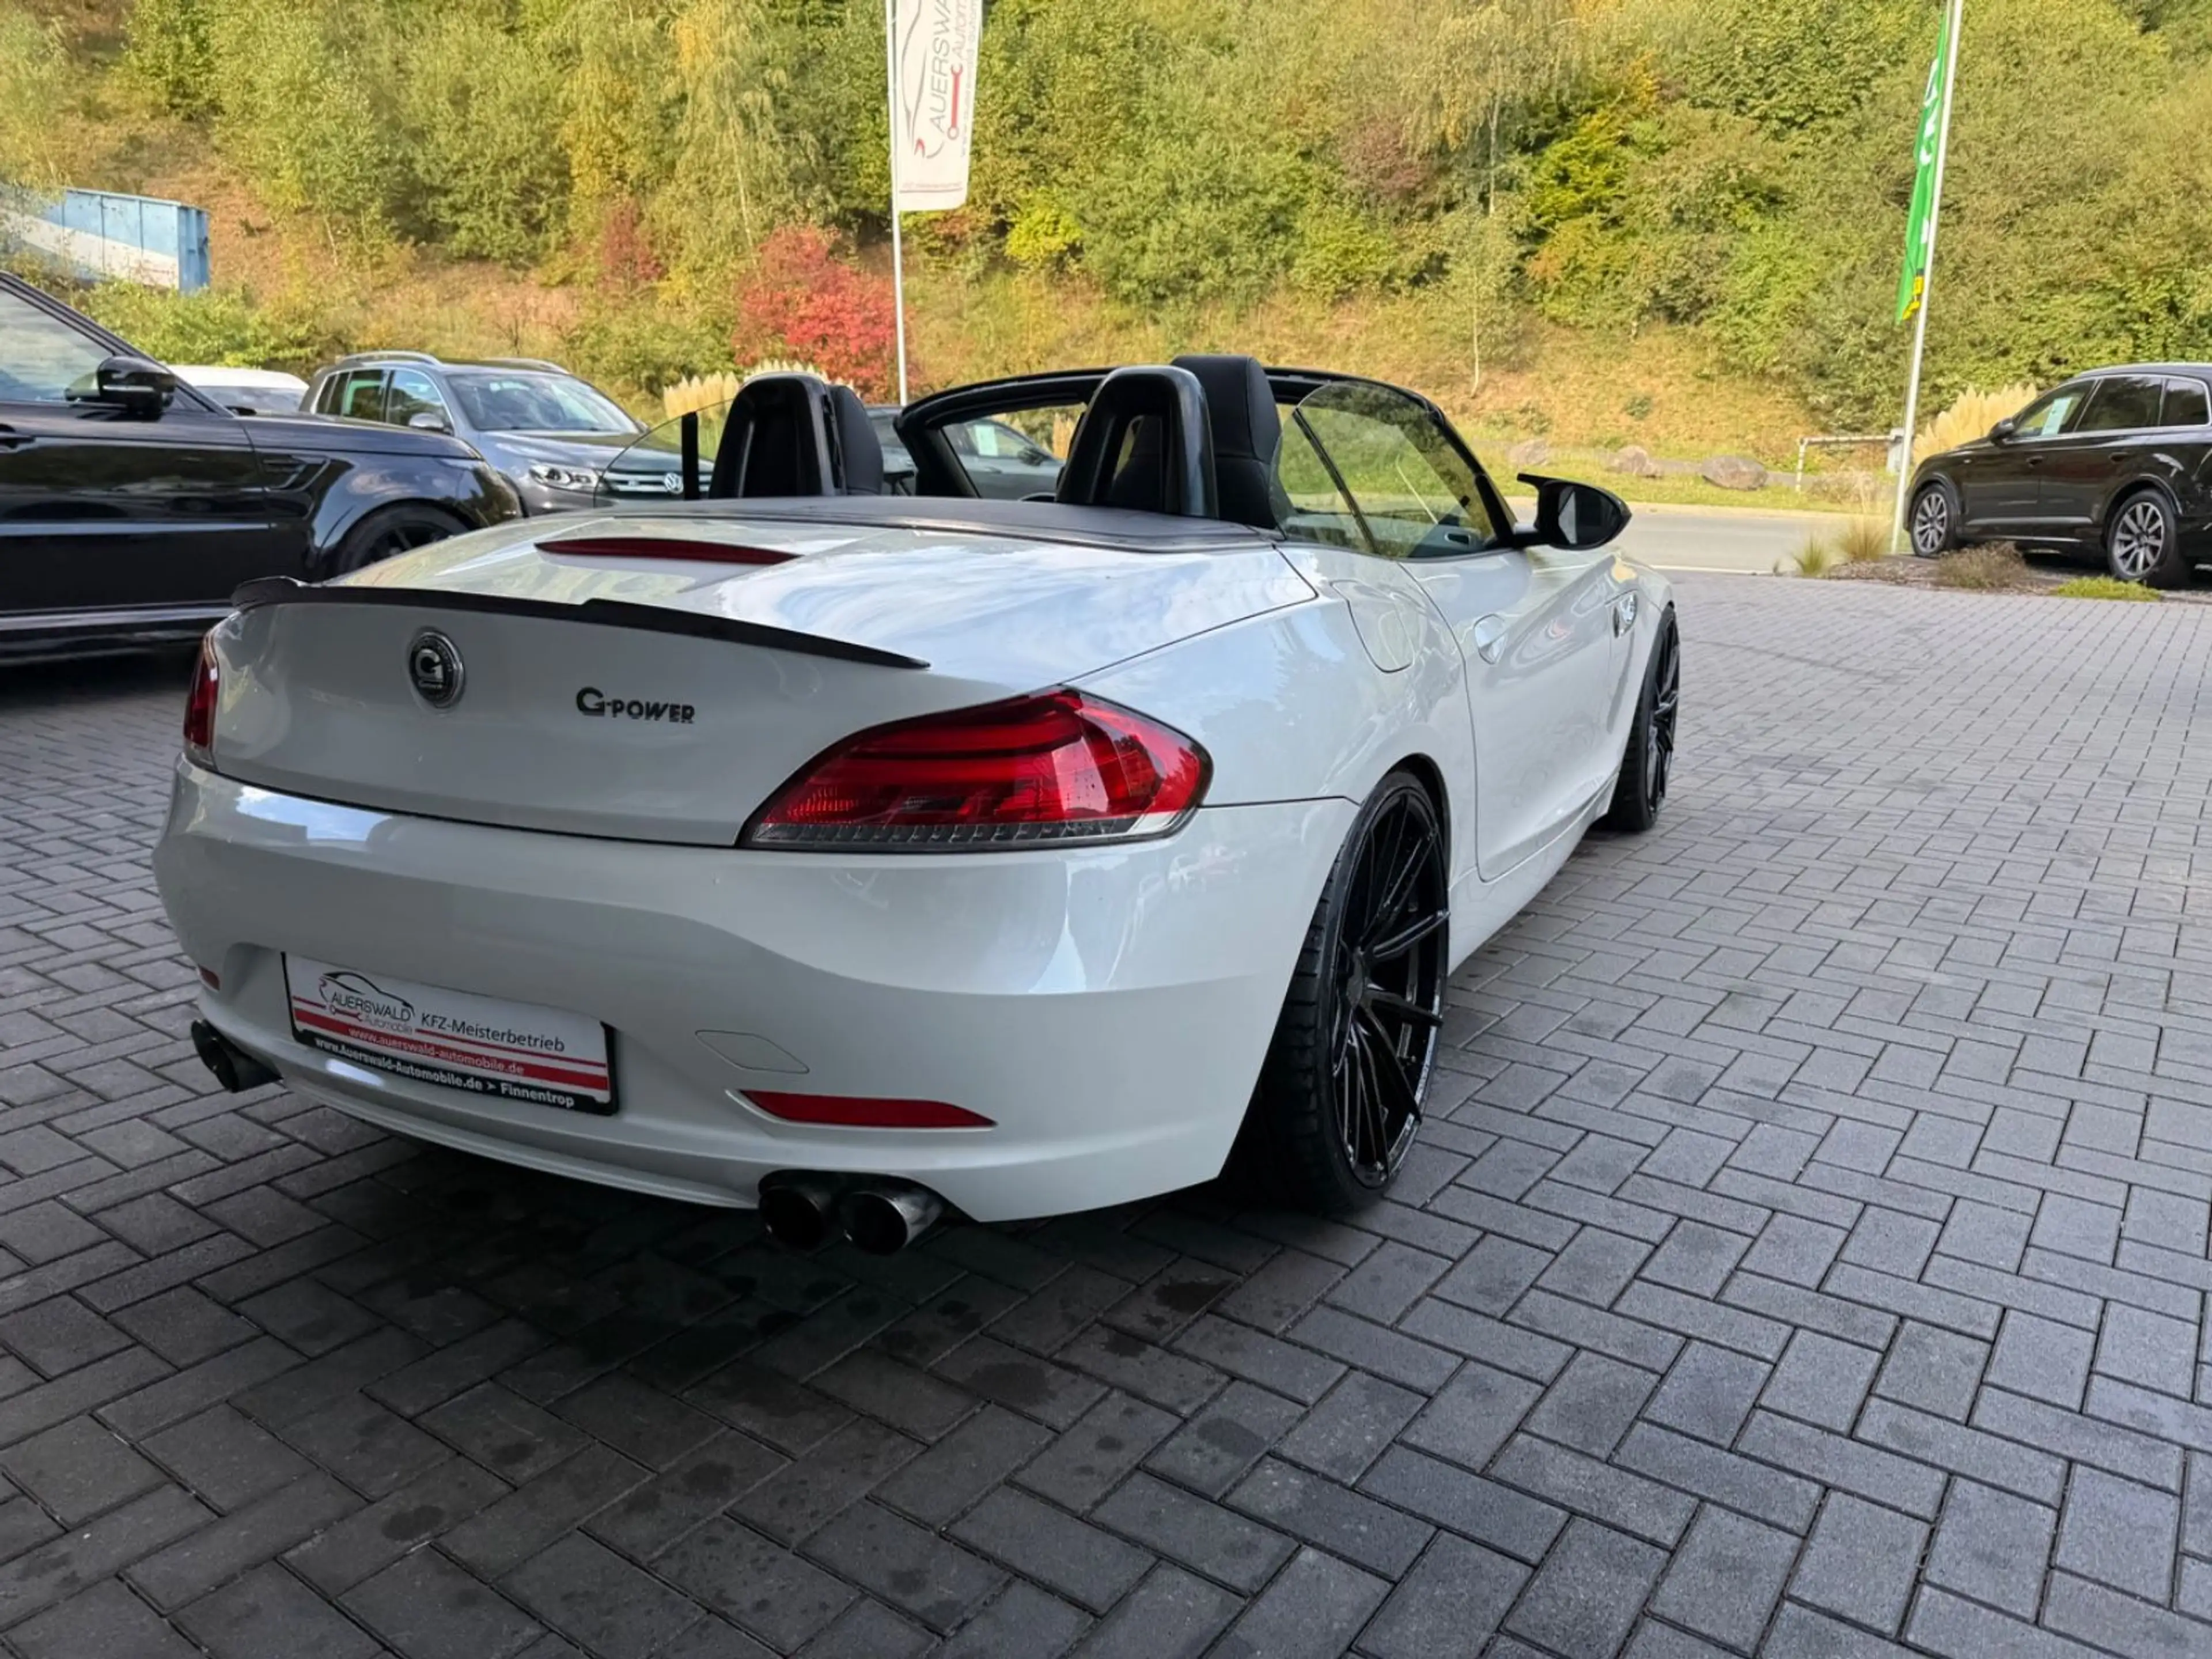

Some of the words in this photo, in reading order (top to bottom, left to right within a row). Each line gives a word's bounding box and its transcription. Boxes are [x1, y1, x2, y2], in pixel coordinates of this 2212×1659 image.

[331, 991, 411, 1022] AUERSWALD
[421, 1012, 565, 1052] KFZ-Meisterbetrieb
[348, 1028, 524, 1075] www.auerswald-automobile.de
[499, 1082, 575, 1108] Finnentrop
